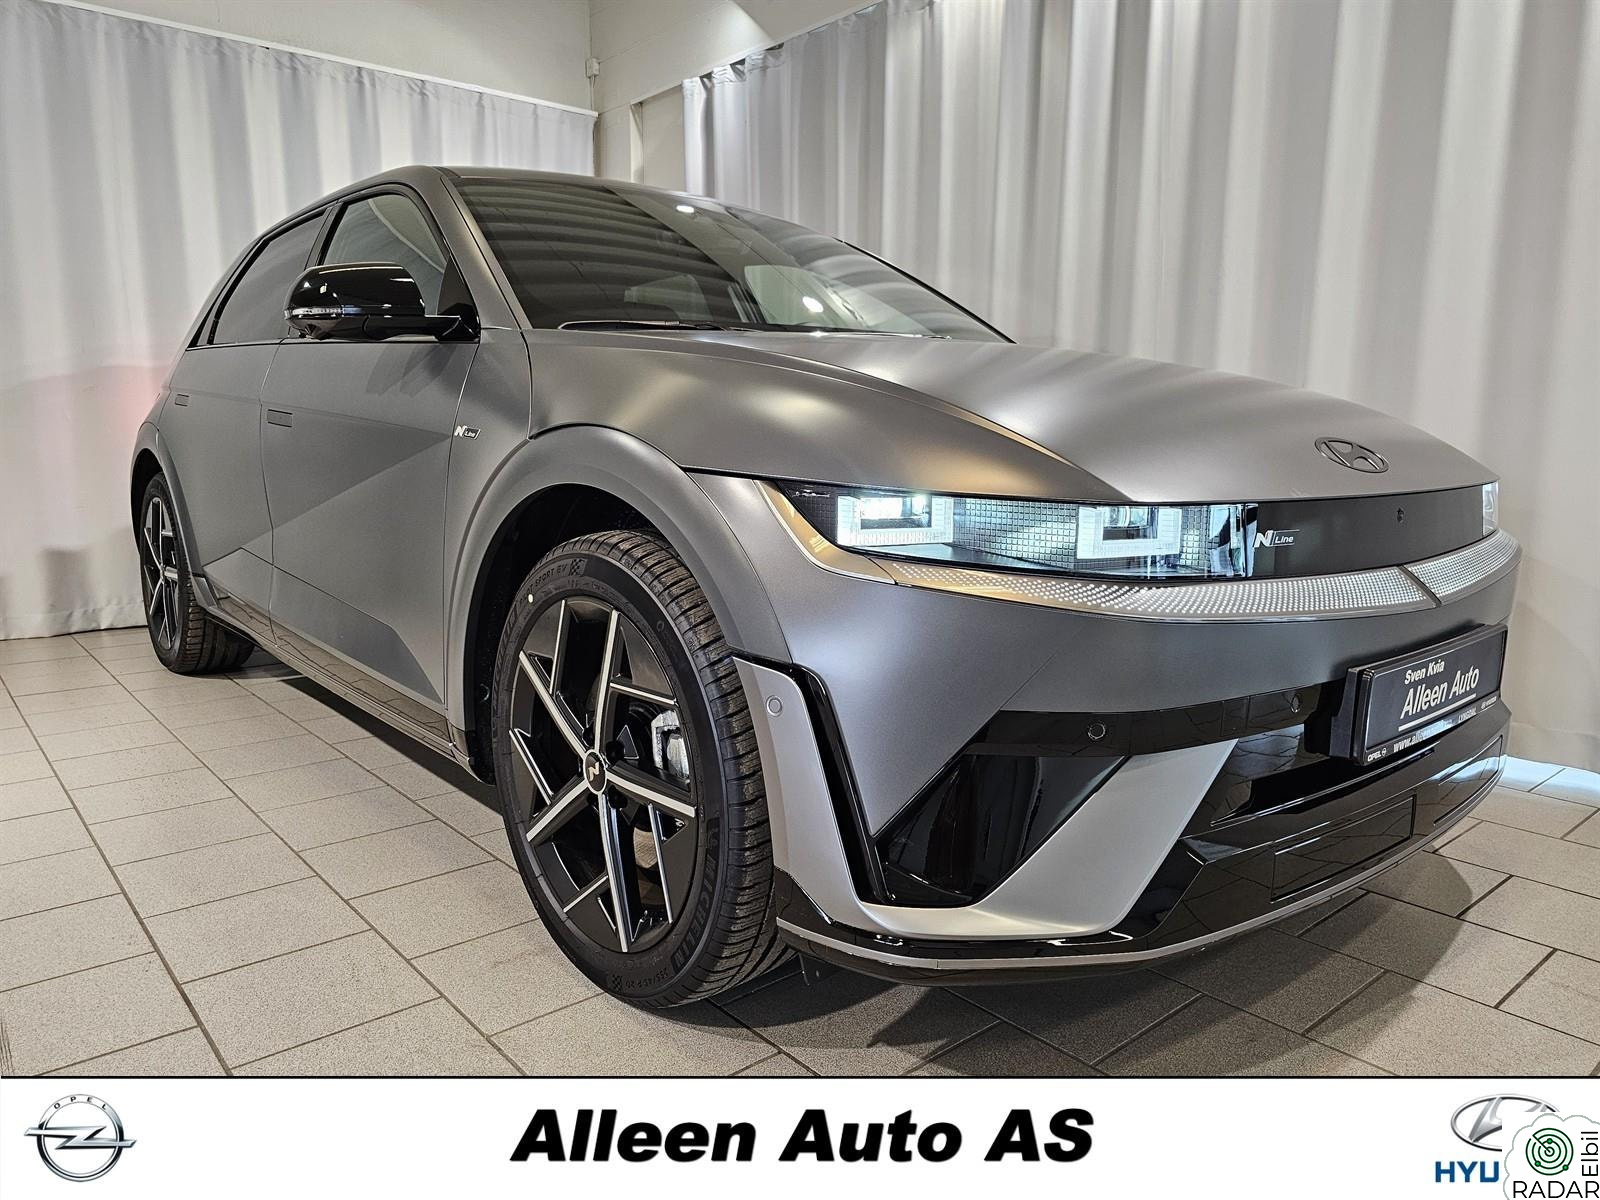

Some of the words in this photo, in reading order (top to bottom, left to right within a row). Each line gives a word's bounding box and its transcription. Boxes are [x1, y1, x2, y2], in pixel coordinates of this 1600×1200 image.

[1254, 530, 1274, 548] N
[1275, 535, 1294, 544] Line
[535, 568, 555, 587] SPORT
[1404, 669, 1426, 685] Sven
[1427, 659, 1445, 677] Kvia
[1400, 681, 1448, 719] Alleen
[1449, 665, 1480, 699] Auto
[674, 853, 717, 968] MICHELIN
